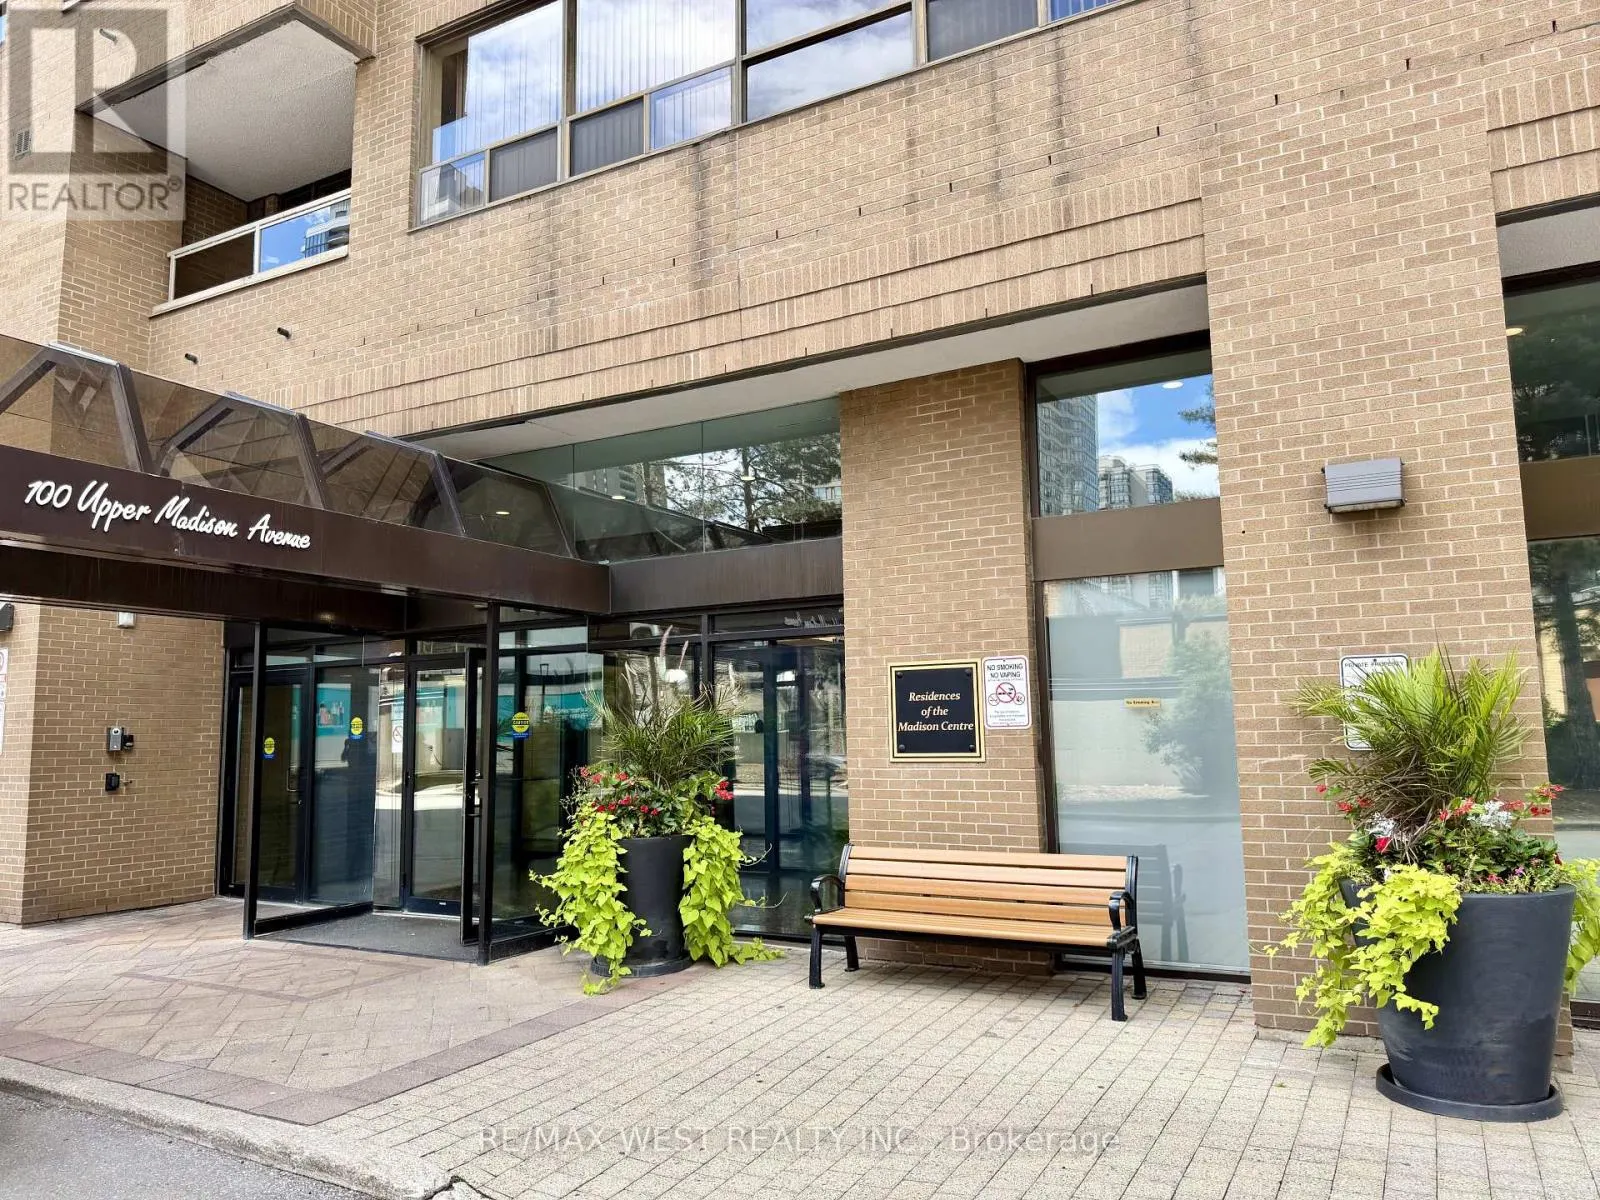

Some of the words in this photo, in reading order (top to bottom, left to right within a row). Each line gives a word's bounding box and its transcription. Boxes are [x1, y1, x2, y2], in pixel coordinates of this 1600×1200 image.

[24, 480, 72, 509] 100
[77, 480, 151, 532] Upper
[154, 496, 238, 538] Madison
[247, 513, 311, 549] Avenue
[997, 663, 1024, 671] SMOKING
[908, 691, 961, 702] Residences
[921, 706, 933, 718] of
[932, 705, 949, 716] the
[898, 721, 939, 732] Madison
[940, 721, 974, 731] Centre
